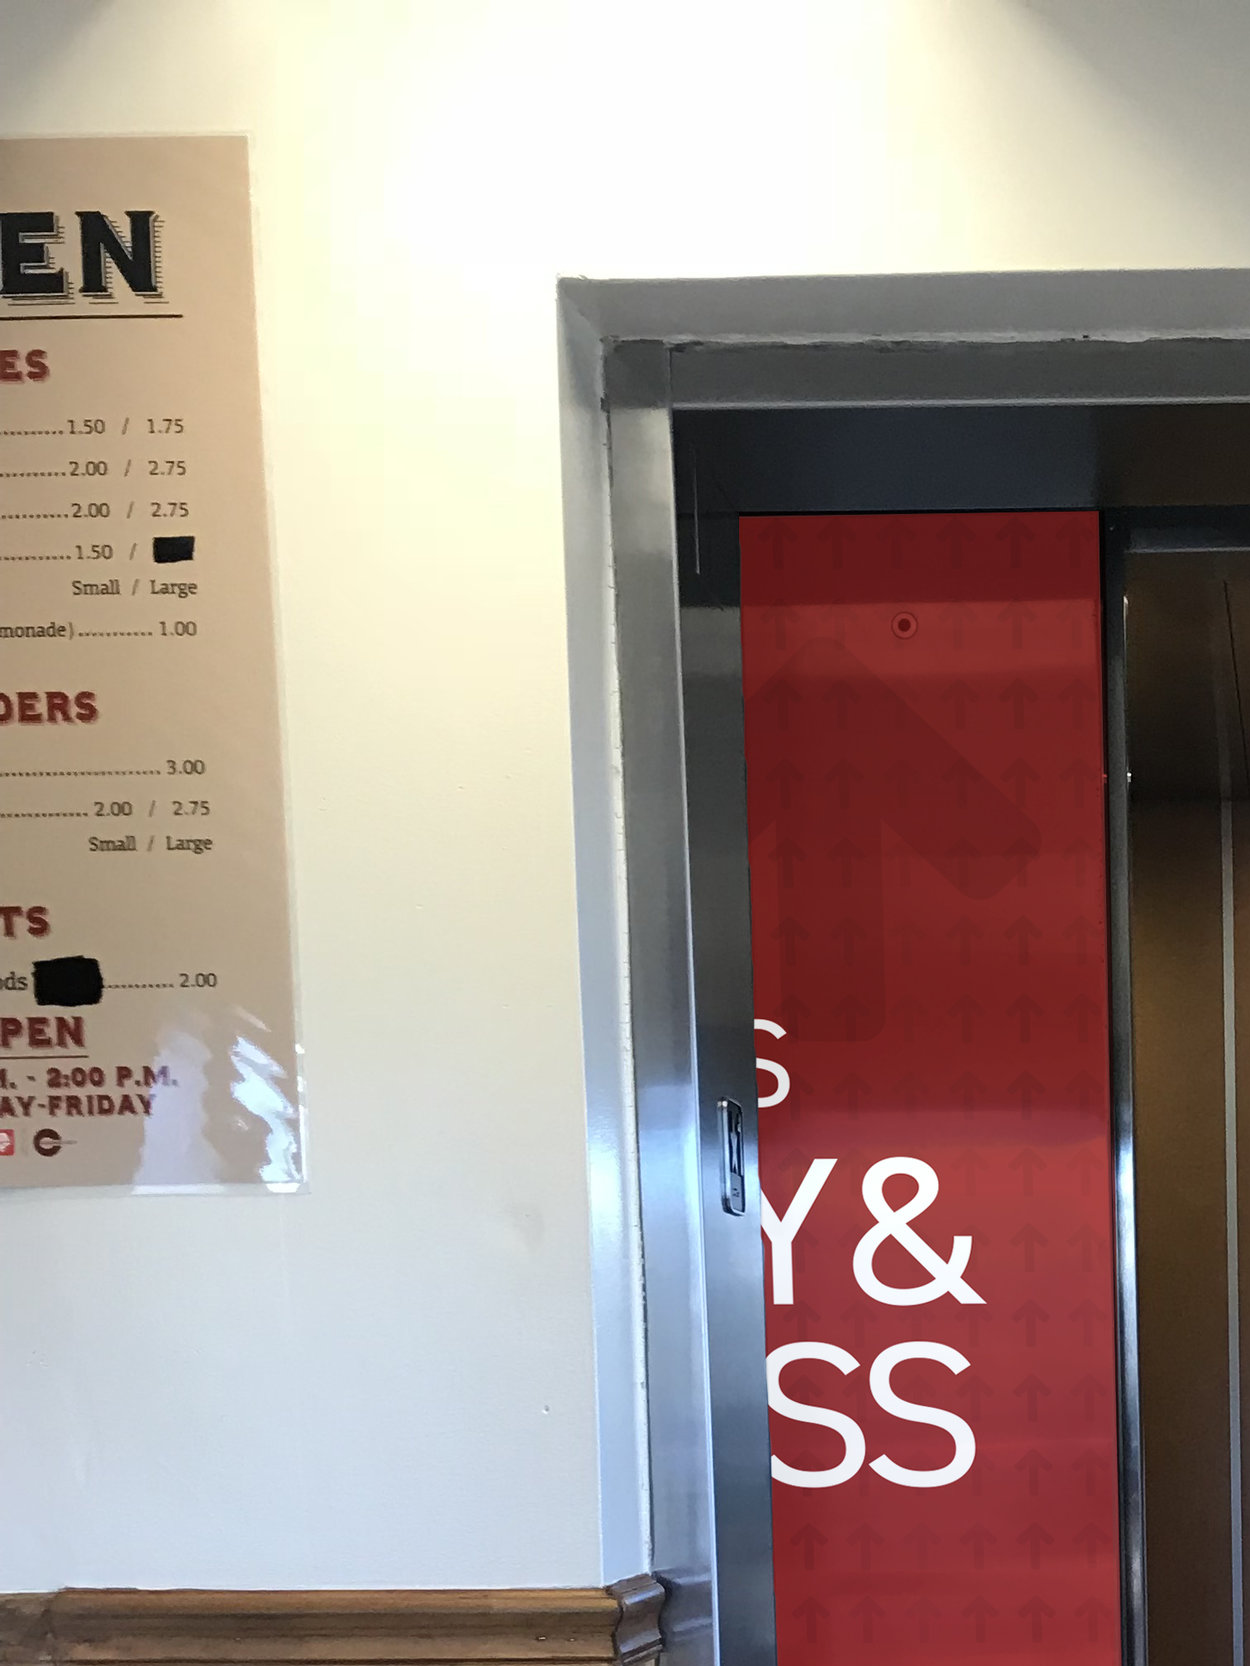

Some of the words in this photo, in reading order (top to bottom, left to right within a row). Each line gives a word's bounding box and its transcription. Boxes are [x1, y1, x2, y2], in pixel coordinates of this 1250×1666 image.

[67, 418, 106, 435] 1.50
[146, 418, 184, 434] 1.75
[68, 460, 108, 477] 2.00
[147, 460, 187, 476] 2.75
[71, 502, 111, 519] 2.00
[150, 501, 190, 518] 2.75
[75, 544, 114, 561] 1.50
[72, 580, 120, 595] Small
[150, 580, 197, 598] Large
[159, 620, 198, 637] 1.00
[166, 759, 206, 776] 3.00
[93, 801, 133, 817] 2.00
[172, 800, 211, 816] 2.75
[89, 836, 136, 851] Small
[166, 836, 212, 854] Large
[179, 972, 218, 988] 2.00
[46, 1066, 106, 1089] 2:00
[115, 1065, 178, 1088] P.M.
